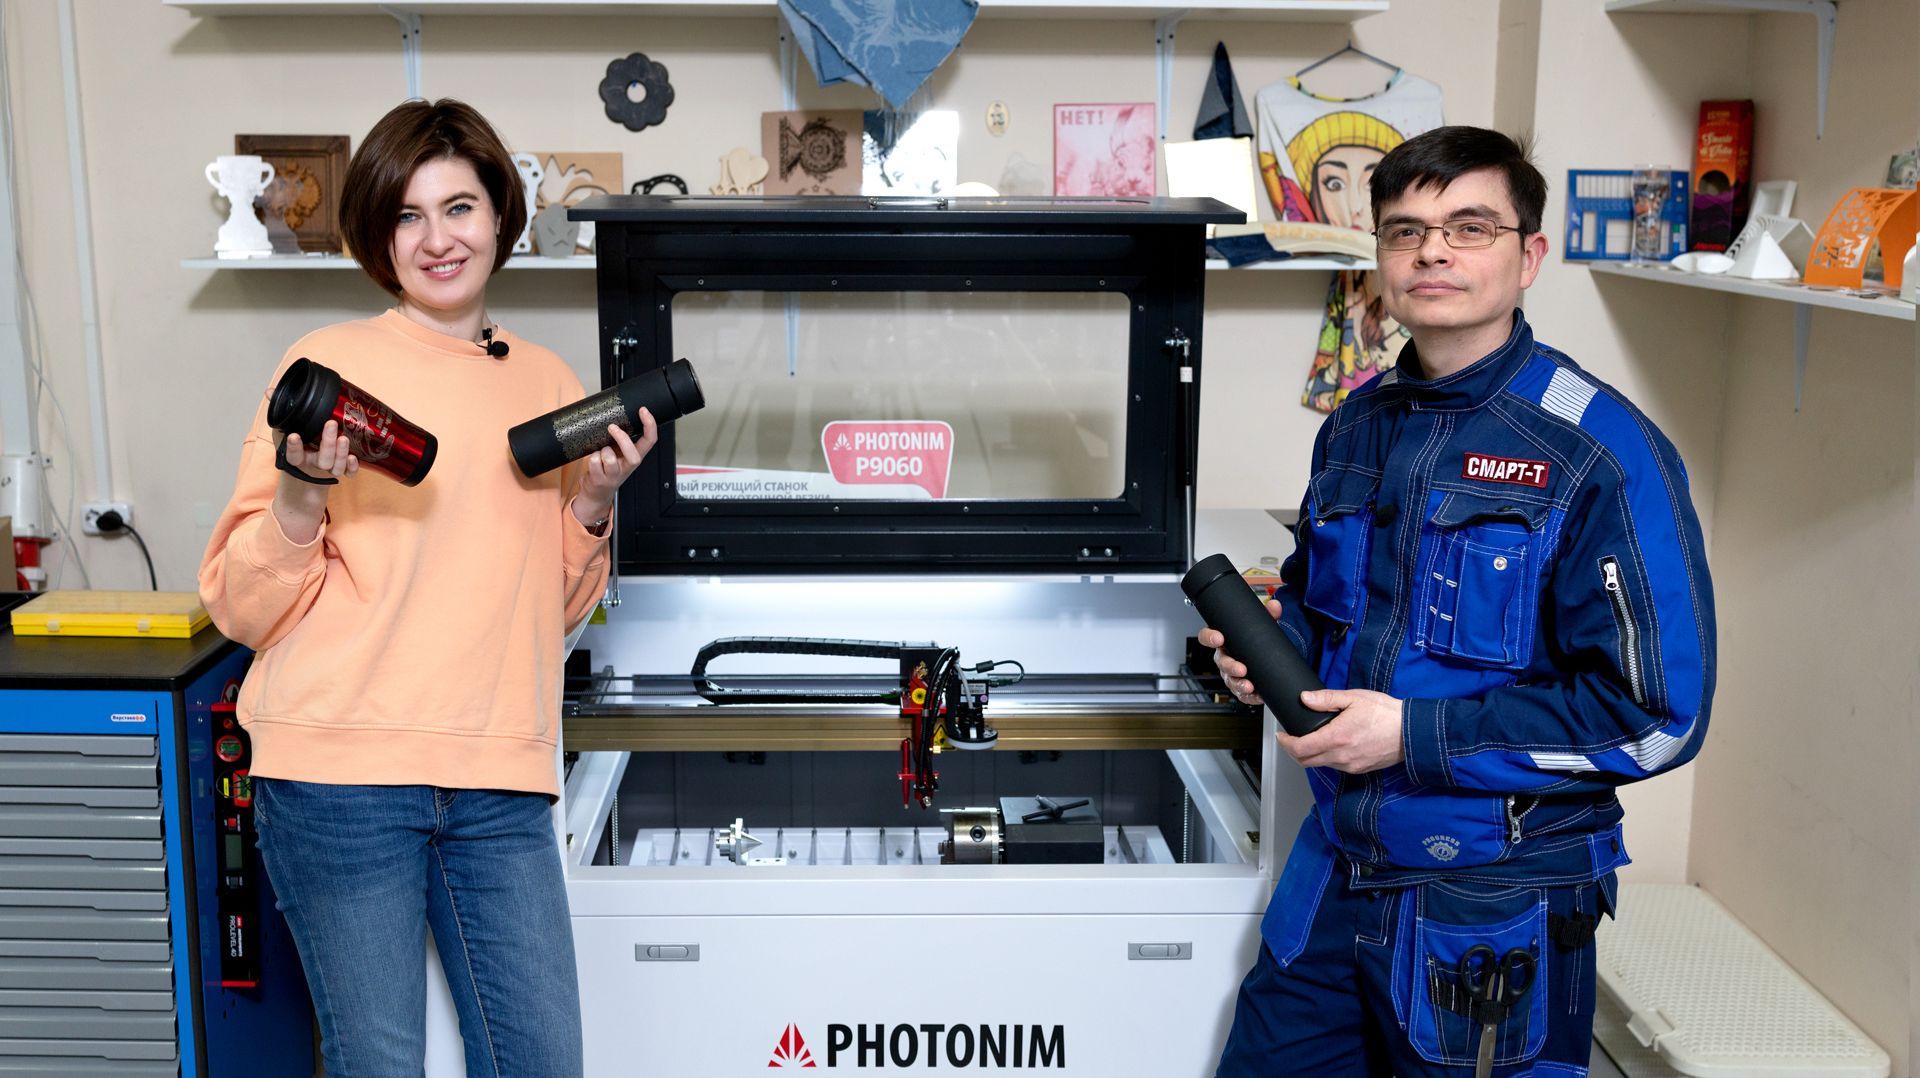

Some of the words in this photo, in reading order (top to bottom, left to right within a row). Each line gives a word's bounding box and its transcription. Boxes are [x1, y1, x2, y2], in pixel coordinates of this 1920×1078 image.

[1061, 110, 1104, 125] НЕТ!
[854, 431, 945, 451] PHOTONIM
[855, 456, 923, 476] P9060
[1467, 457, 1545, 483] СМАРТ-Т
[701, 480, 762, 493] РЕЖУЩИЙ
[764, 482, 808, 491] СТАНОК
[229, 915, 237, 948] PROLEVEL
[827, 1023, 1066, 1068] PHOTONIM
